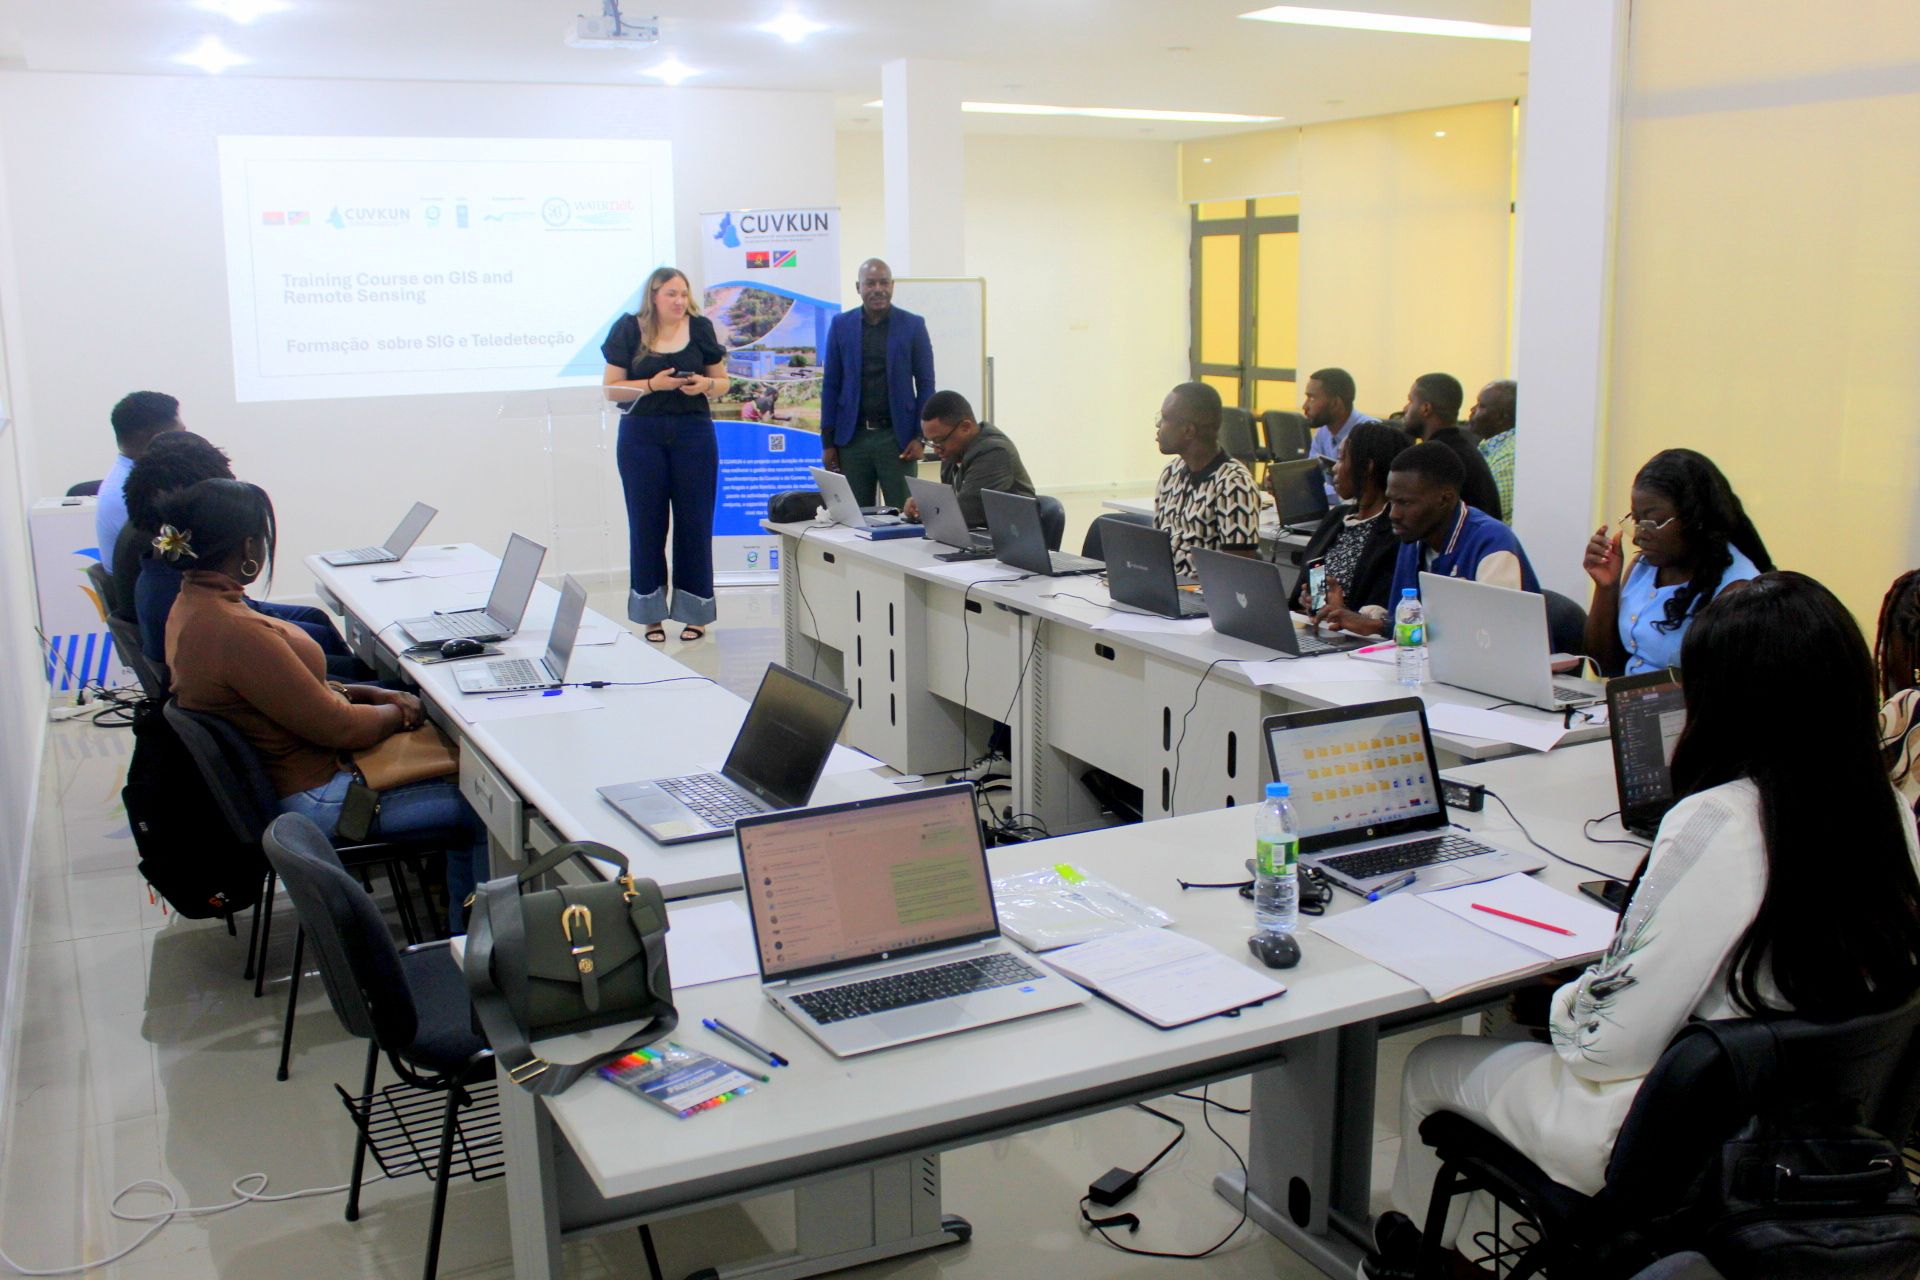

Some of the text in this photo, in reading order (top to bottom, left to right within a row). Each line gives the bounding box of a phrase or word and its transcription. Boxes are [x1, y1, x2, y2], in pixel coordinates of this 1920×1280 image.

[344, 207, 411, 221] CUVKUN
[740, 213, 828, 233] CUVKUN
[281, 270, 513, 290] Training Course on GIS and
[284, 287, 427, 305] Remote Sensing
[286, 331, 575, 355] Formação sobre SIG e Teledetecção
